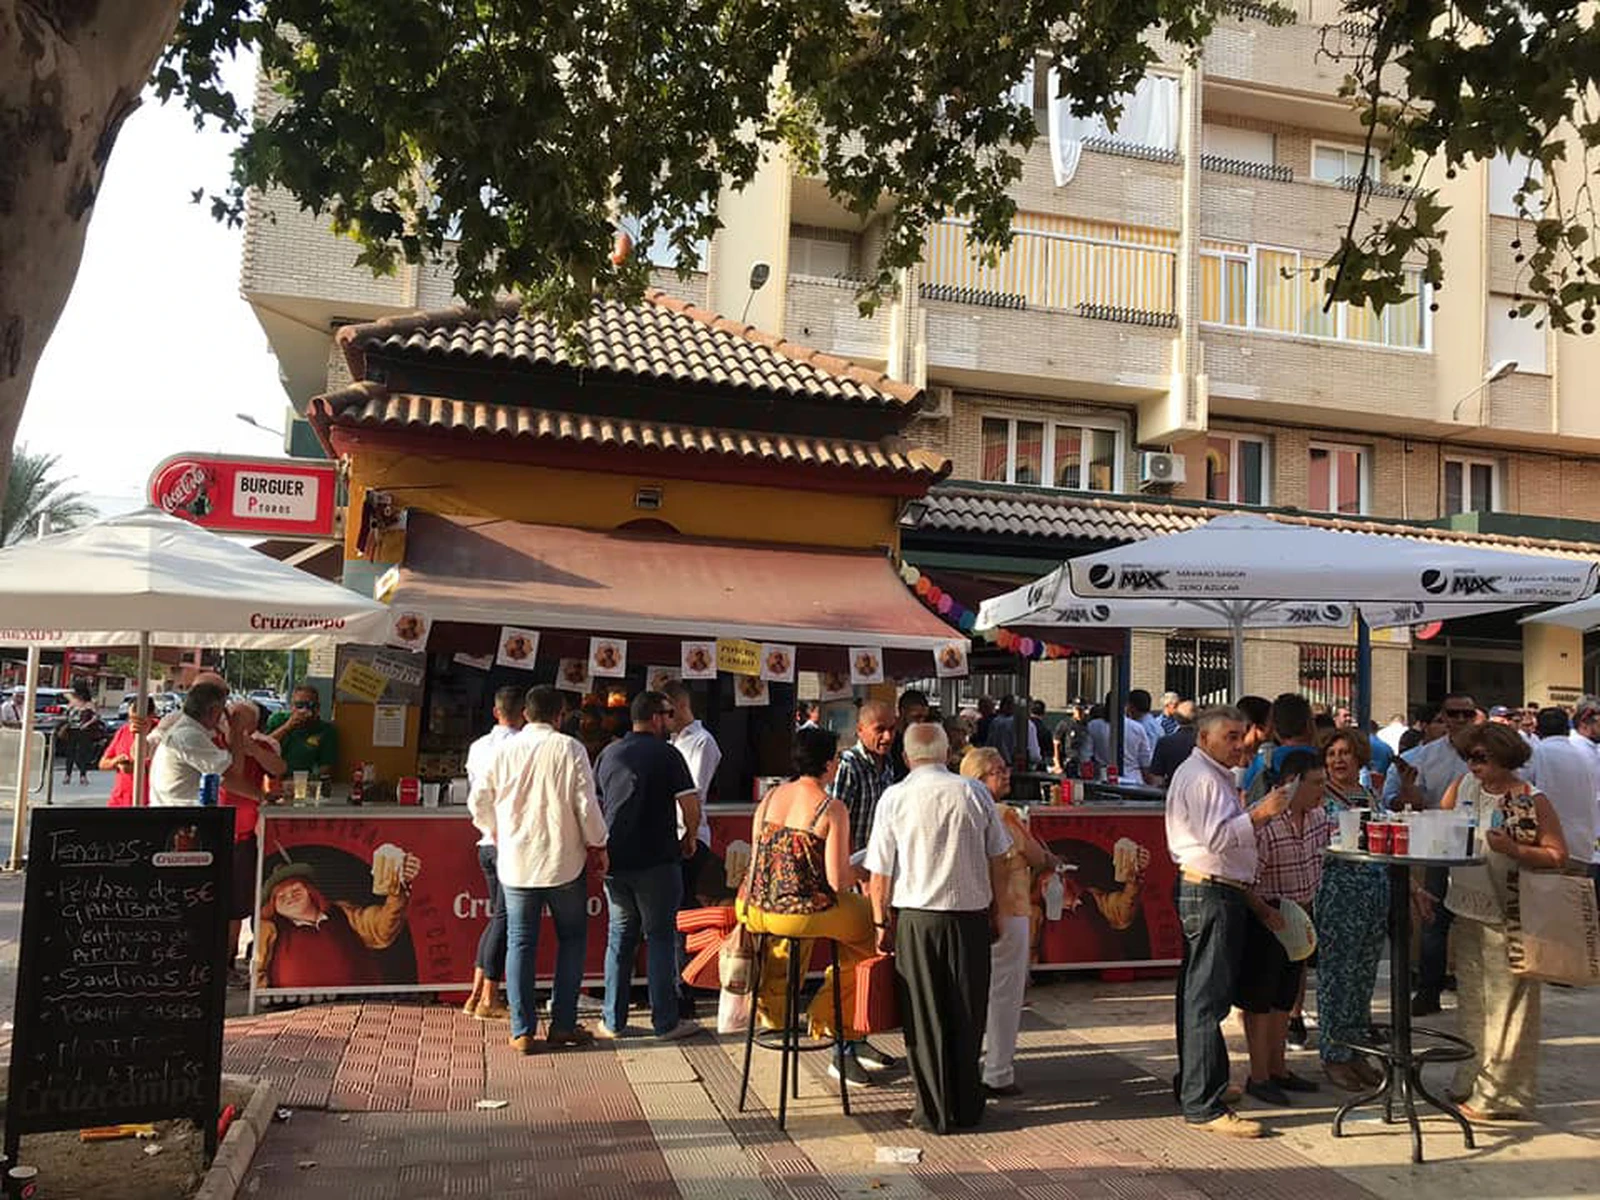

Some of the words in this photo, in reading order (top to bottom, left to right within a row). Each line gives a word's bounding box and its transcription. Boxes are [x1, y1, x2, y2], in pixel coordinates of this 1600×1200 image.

[240, 477, 305, 497] BURGUER
[1118, 569, 1171, 591] MAX
[1451, 575, 1503, 596] MAX
[250, 612, 346, 630] Cruzcampo
[59, 965, 181, 989] Sardinas
